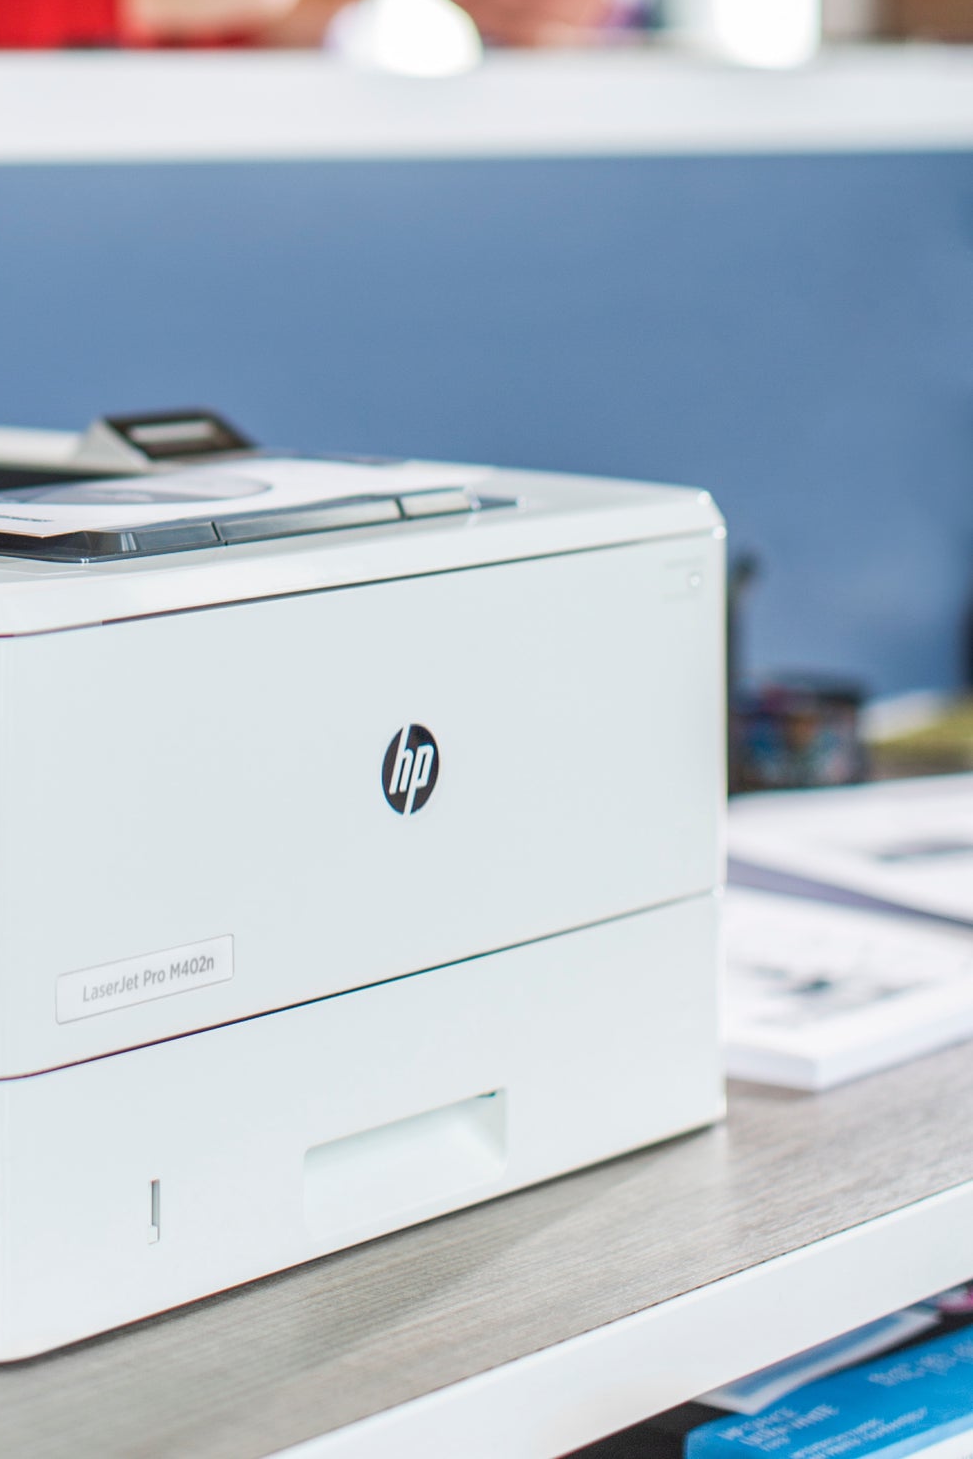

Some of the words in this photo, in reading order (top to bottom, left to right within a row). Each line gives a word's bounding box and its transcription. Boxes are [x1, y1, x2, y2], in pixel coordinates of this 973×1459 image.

[387, 723, 436, 815] hp
[82, 973, 140, 1003] LaserJet
[143, 969, 166, 987] Pro
[170, 955, 215, 980] M402n
